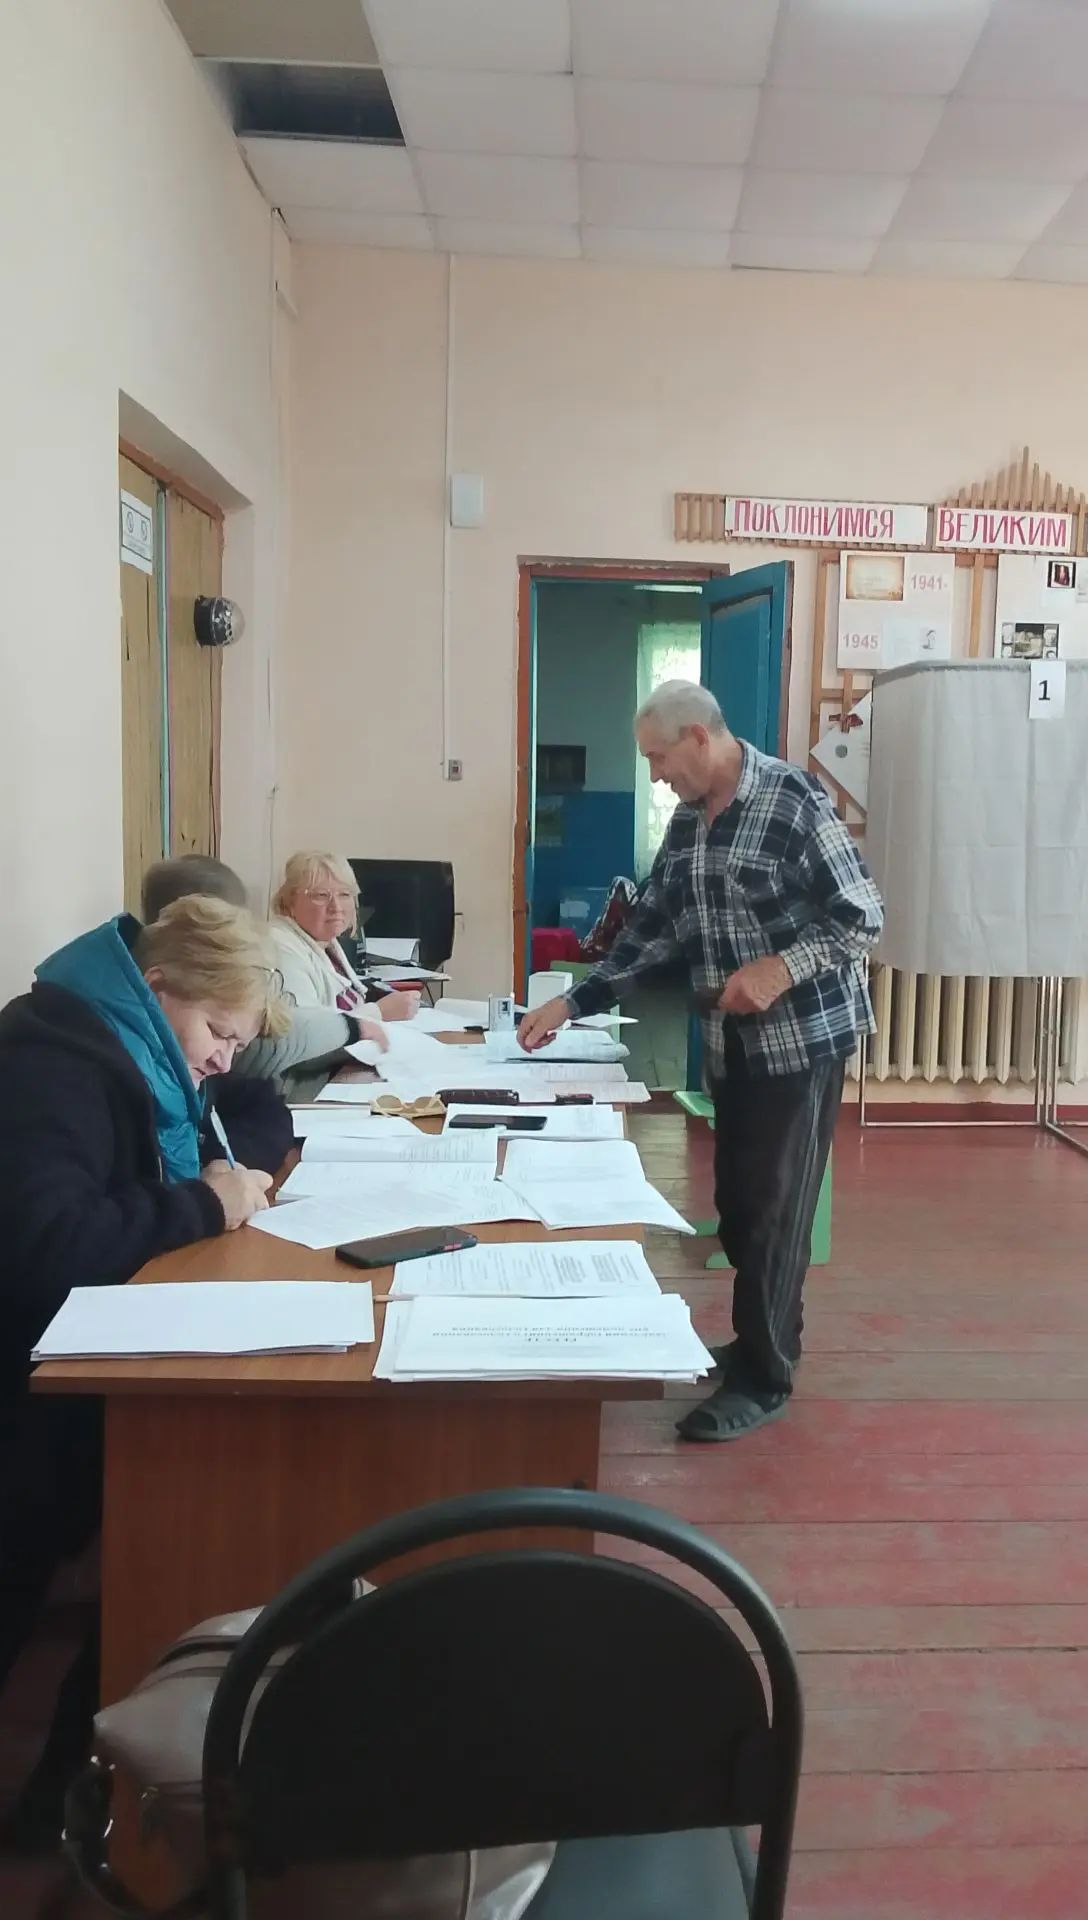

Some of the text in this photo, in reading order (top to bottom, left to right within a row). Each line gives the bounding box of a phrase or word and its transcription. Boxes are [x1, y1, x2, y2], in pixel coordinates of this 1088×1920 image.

[938, 509, 1067, 547] ВЕЛИКИМ
[842, 633, 879, 649] 1945
[1038, 679, 1051, 701] 1
